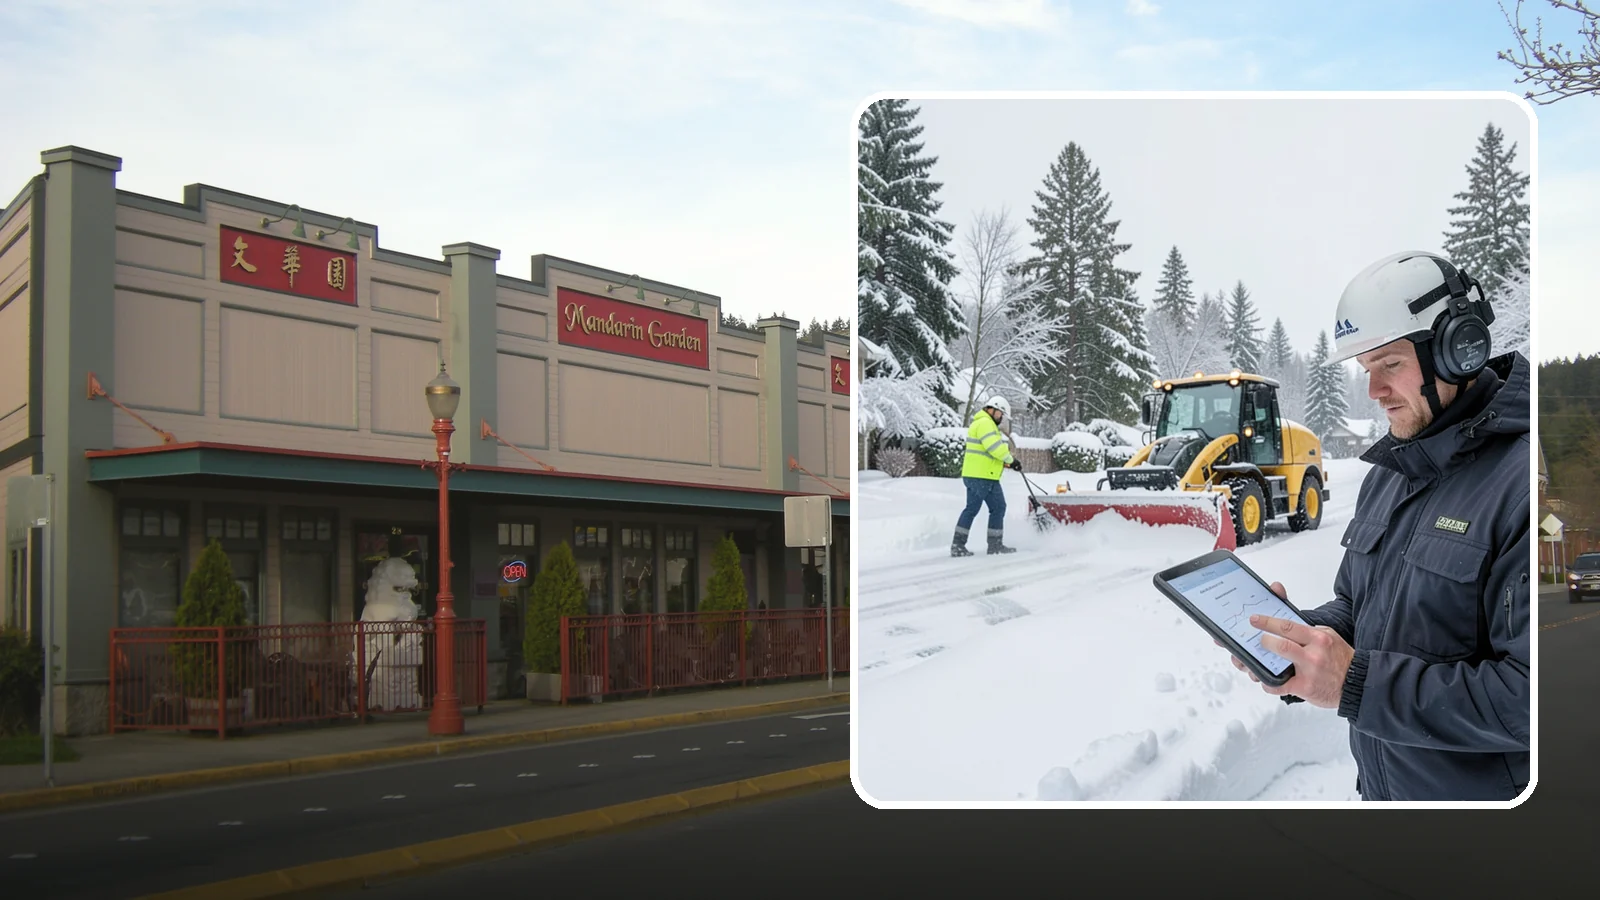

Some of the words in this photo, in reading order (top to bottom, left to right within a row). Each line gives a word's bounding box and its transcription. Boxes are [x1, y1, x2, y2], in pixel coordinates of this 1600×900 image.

[231, 236, 346, 291] 文華園
[565, 302, 644, 340] Mandarin
[648, 320, 702, 352] Garden
[503, 565, 527, 578] OPEN
